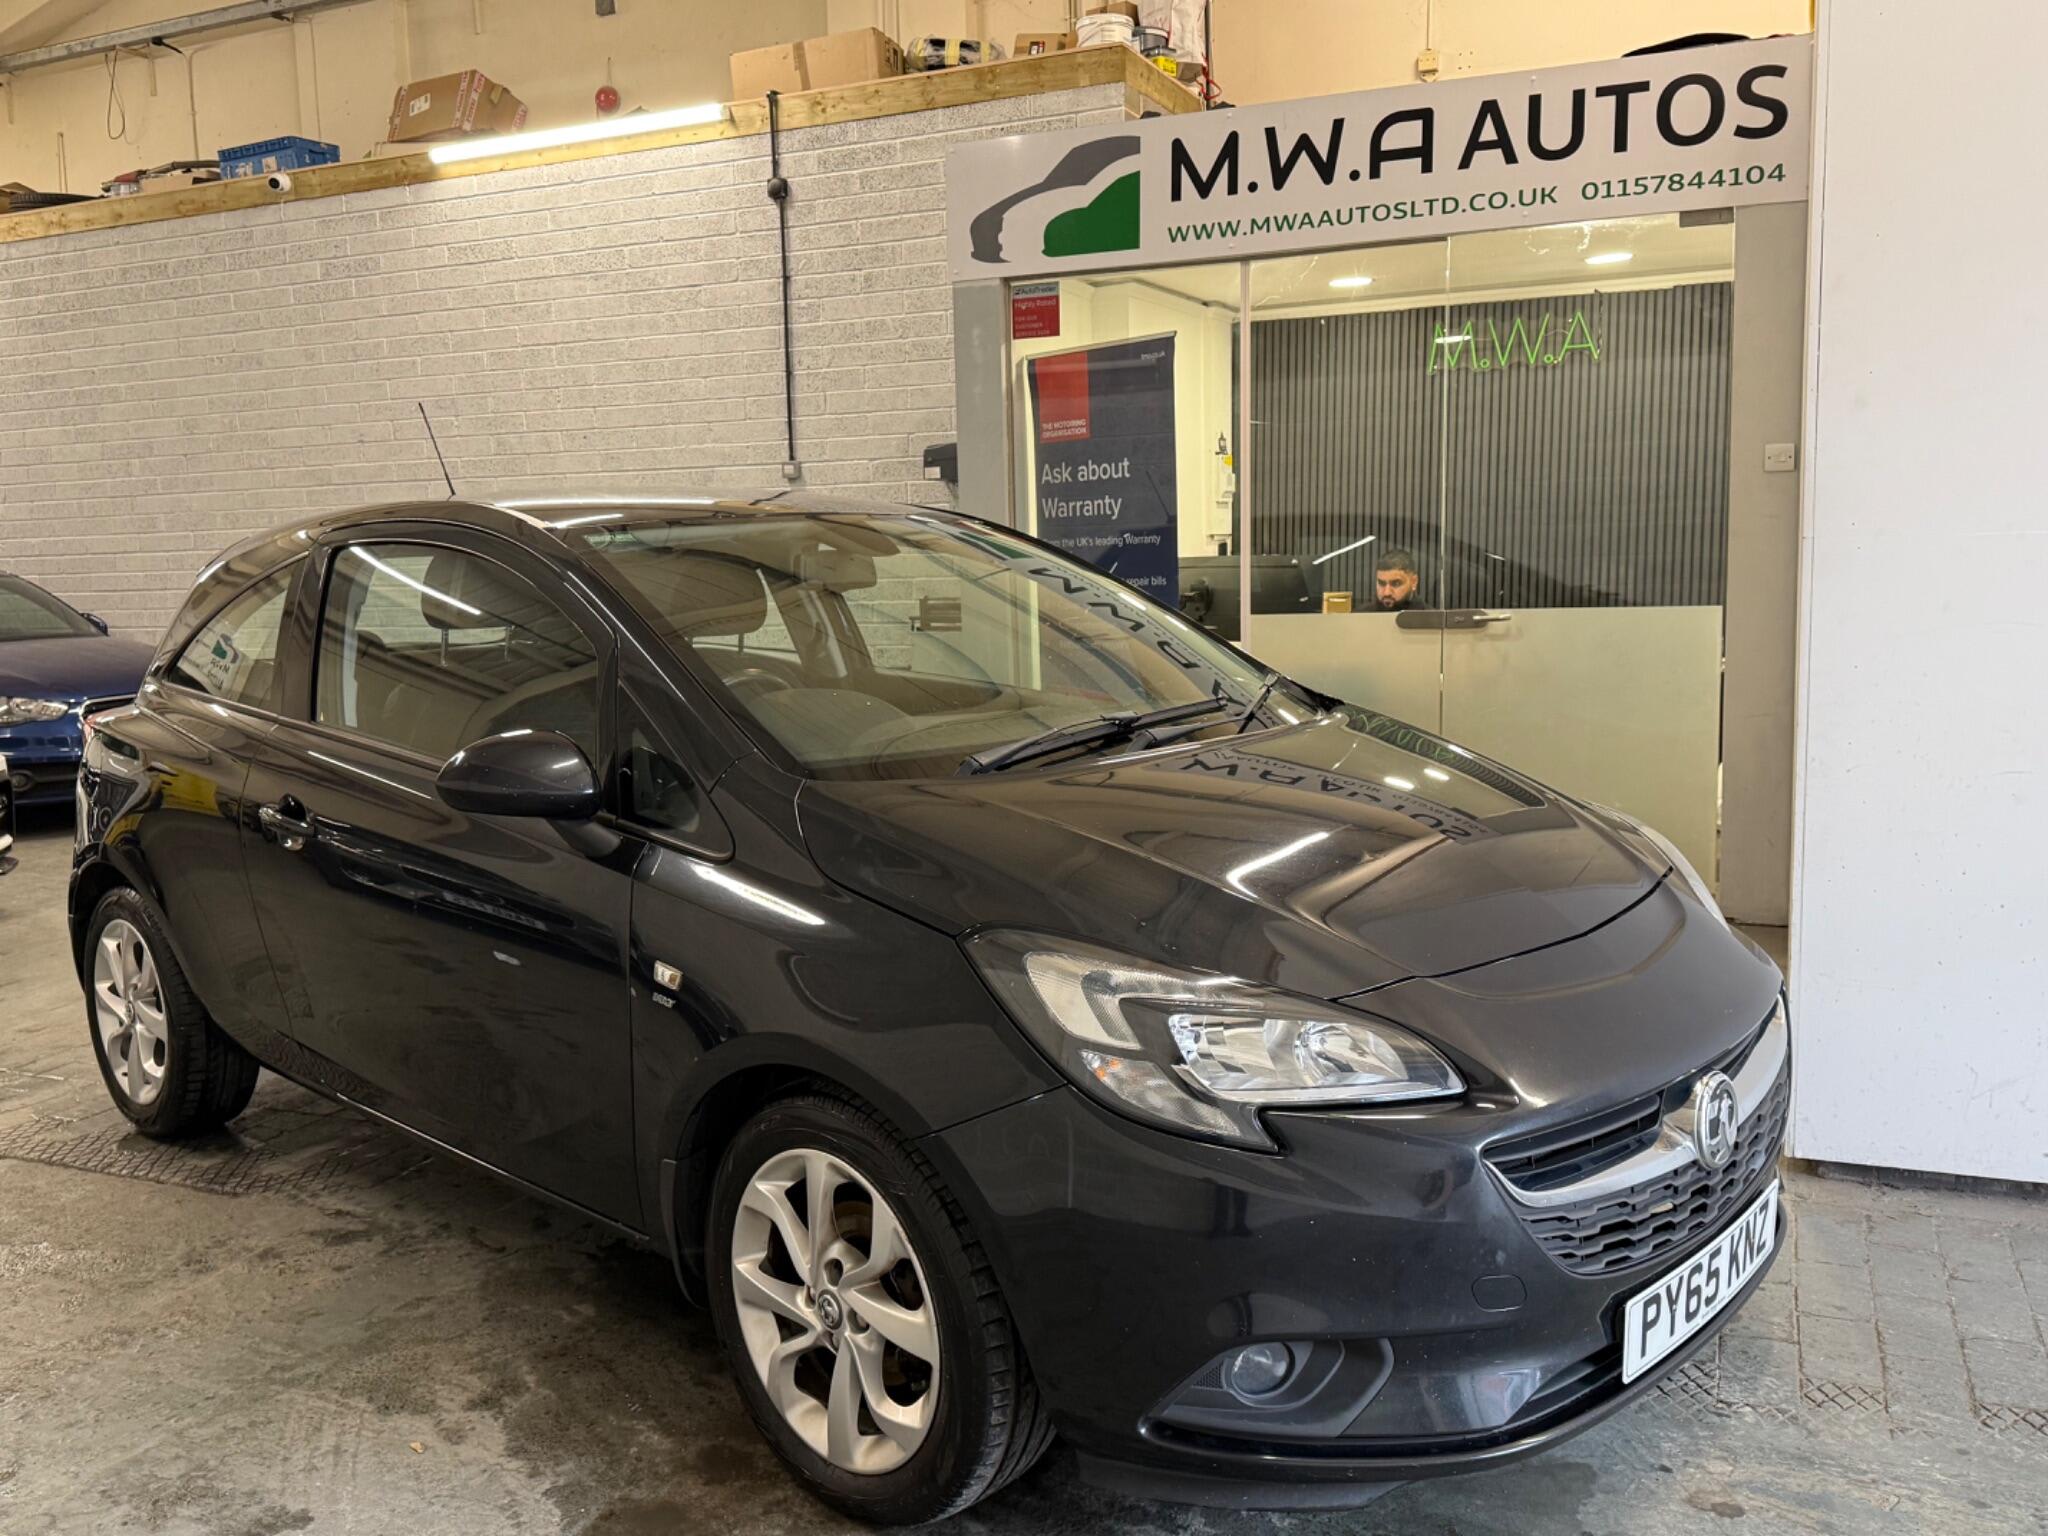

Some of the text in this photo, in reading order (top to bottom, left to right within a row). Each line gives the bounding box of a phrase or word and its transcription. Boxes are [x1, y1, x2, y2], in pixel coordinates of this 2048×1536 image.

[1171, 65, 1789, 202] M.W.A AUTOS
[1168, 163, 1786, 243] WWW.MWAAUTOSLTD.CO.UK 01157844104
[1427, 310, 1600, 375] M.W.A
[1041, 457, 1131, 485] Ask about
[1042, 495, 1122, 520] Warranty
[1076, 536, 1093, 546] UK's
[1095, 534, 1123, 547] leading
[1124, 532, 1161, 546] Warranty
[1151, 575, 1167, 586] bills
[1640, 1197, 1771, 1358] PY65 KNZ
